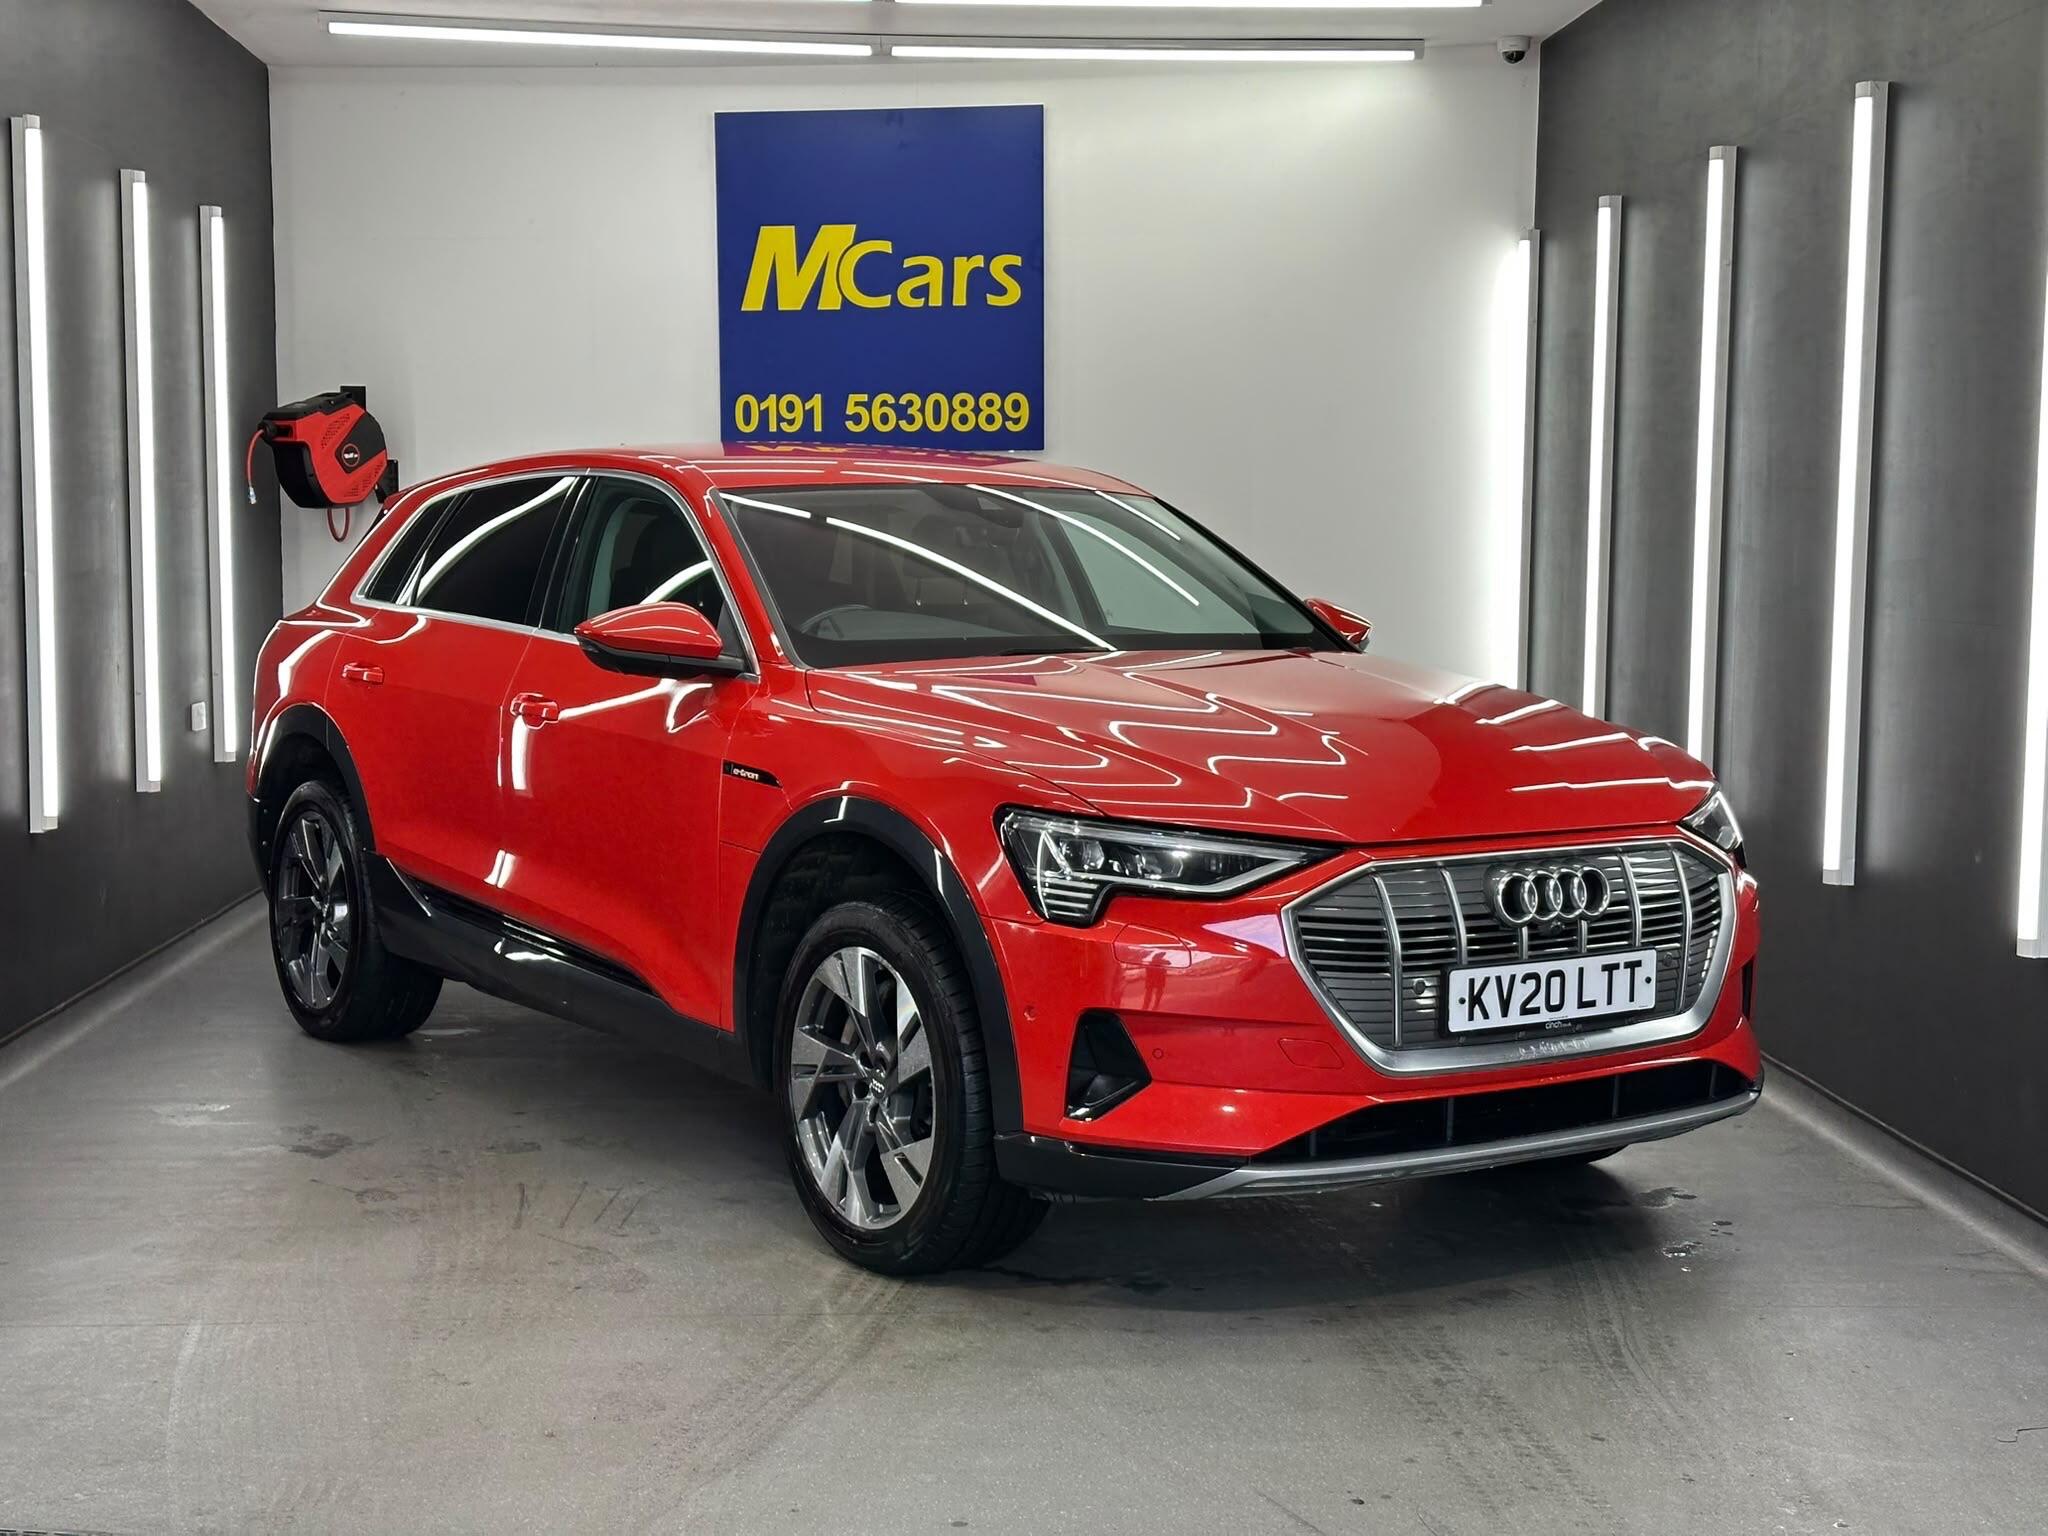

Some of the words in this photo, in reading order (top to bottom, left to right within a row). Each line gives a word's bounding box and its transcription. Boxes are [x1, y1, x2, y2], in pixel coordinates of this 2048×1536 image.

[735, 393, 823, 433] 0191
[845, 392, 1030, 433] 5630889
[733, 768, 759, 780] e-tron
[1468, 969, 1565, 1021] KV20
[1577, 960, 1642, 1009] LTT
